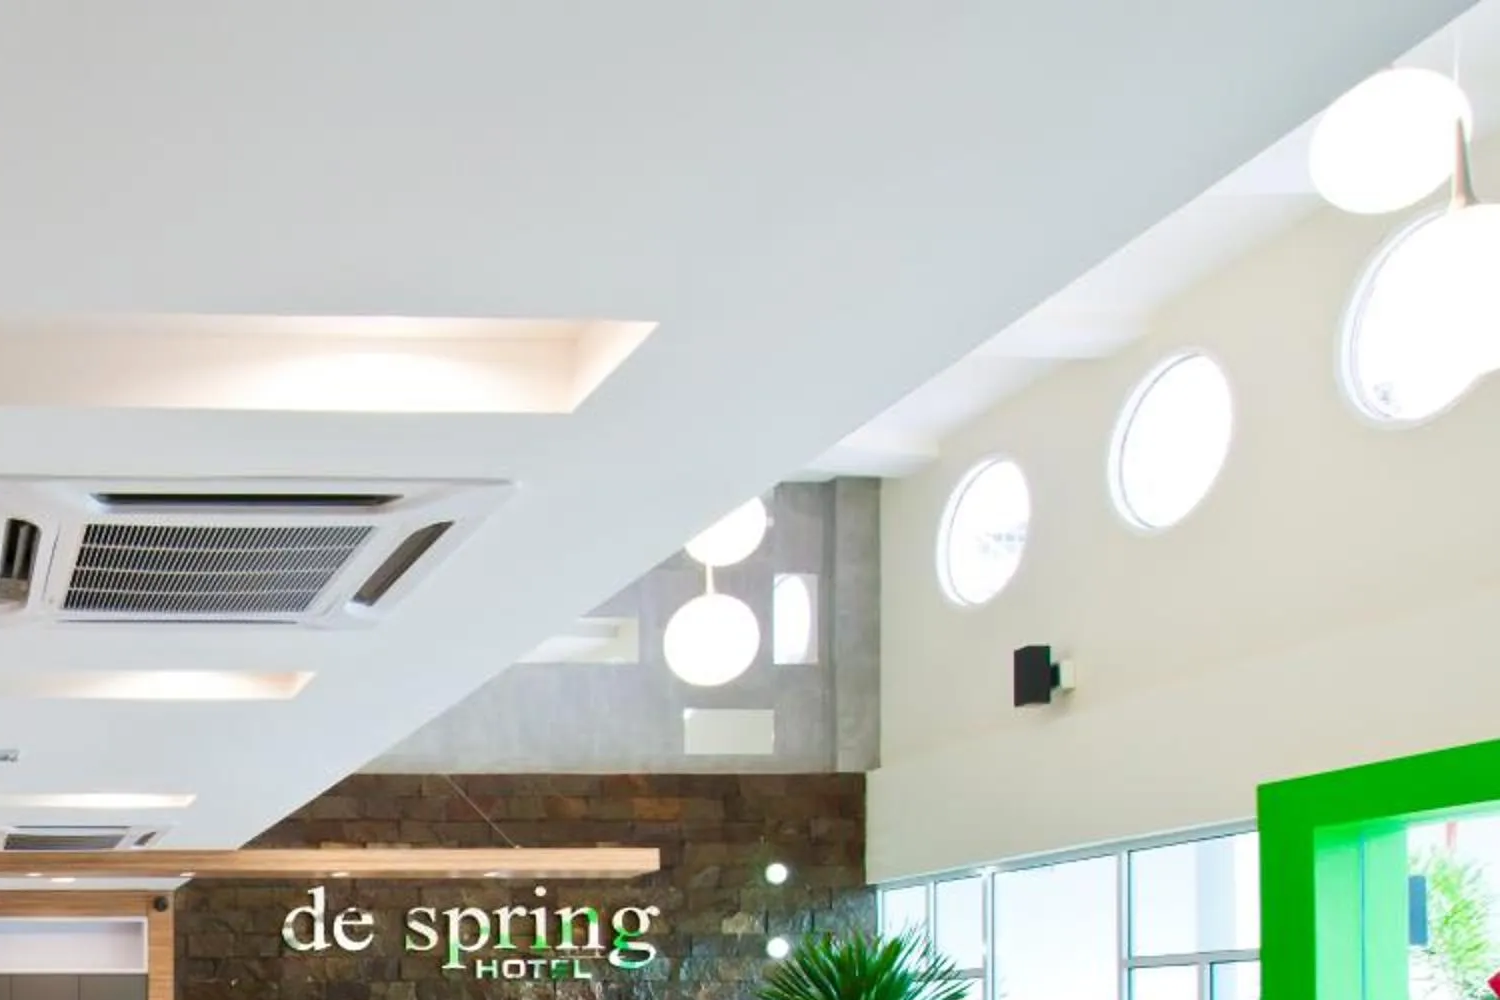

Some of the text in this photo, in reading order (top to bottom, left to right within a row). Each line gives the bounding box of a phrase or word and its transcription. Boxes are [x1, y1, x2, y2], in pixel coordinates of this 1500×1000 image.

[281, 886, 661, 969] de spring
[475, 959, 593, 979] HOTEL
